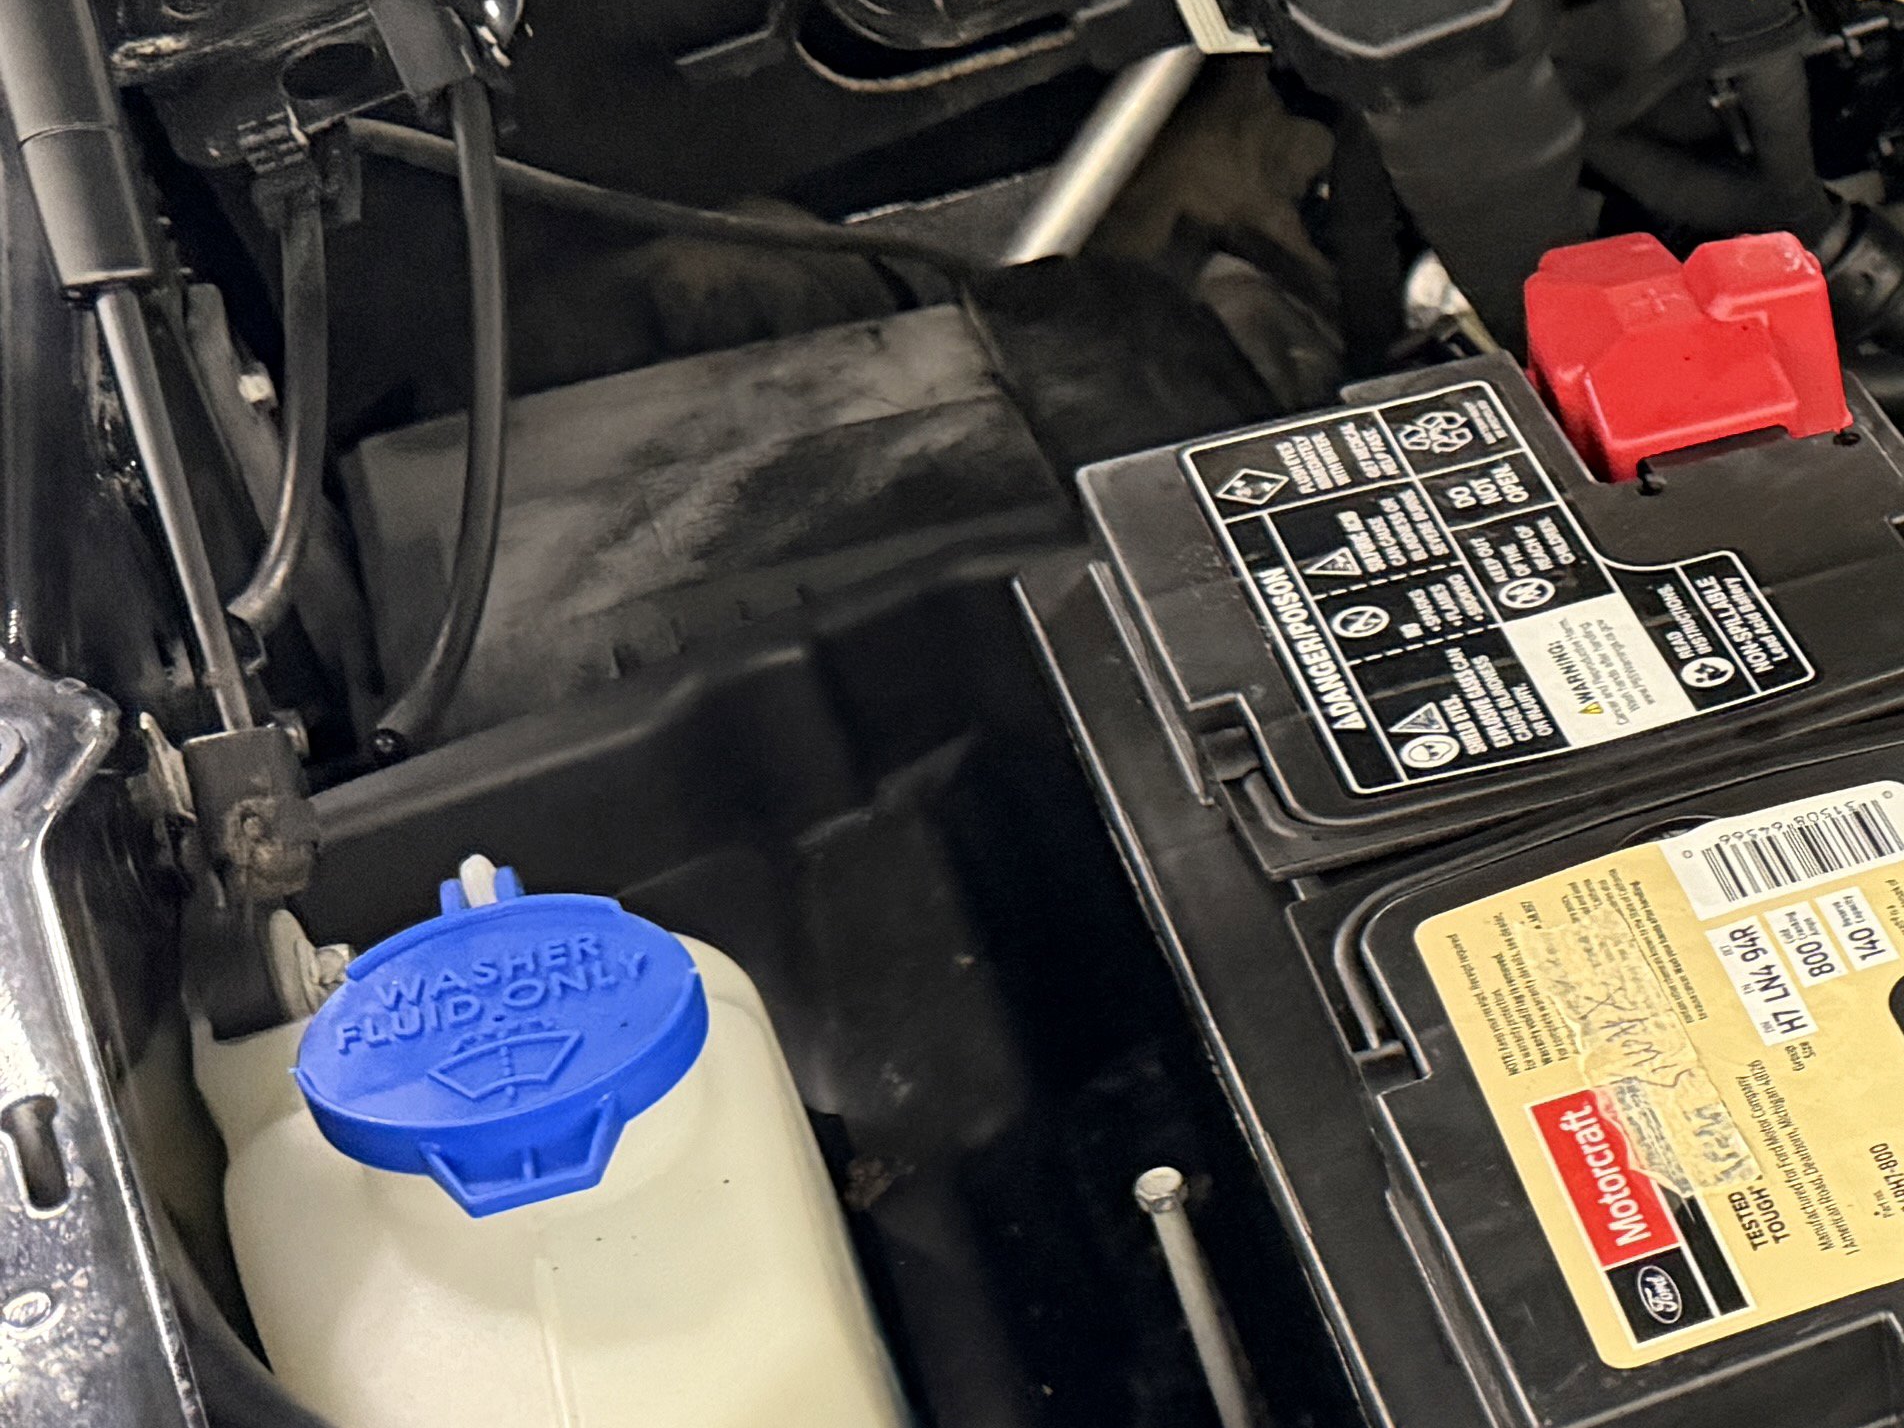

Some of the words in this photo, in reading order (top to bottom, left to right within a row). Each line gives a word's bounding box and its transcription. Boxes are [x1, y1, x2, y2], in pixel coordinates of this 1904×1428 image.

[1448, 486, 1476, 508] DO
[1469, 477, 1502, 504] NOT
[1491, 463, 1528, 502] OPEN.
[1482, 557, 1508, 582] KEEP
[1500, 543, 1523, 564] THE
[1510, 563, 1531, 576] OF
[1723, 577, 1755, 613] Battery
[1696, 576, 1772, 672] NON-SPILLABLE
[1743, 611, 1772, 634] Acid
[1259, 568, 1355, 715] DANGER/POISON
[1445, 647, 1469, 670] CAN
[1666, 631, 1694, 659] READ
[1759, 634, 1788, 661] Lead
[1454, 669, 1485, 698] GASES
[1472, 655, 1513, 708] BLINDNESS
[1548, 640, 1594, 704] WARNING:
[1454, 720, 1487, 754] SHIELD
[1470, 697, 1512, 747] EXPLOSIVE
[1502, 707, 1532, 741] CAUSE
[1531, 719, 1553, 736] OR
[1717, 821, 1784, 847] 64566
[1728, 924, 1767, 962] 94R
[1795, 940, 1835, 977] 800
[1847, 927, 1885, 960] 140
[376, 931, 602, 1012] WASHER
[1749, 964, 1790, 1002] LN4
[336, 994, 483, 1055] FLUID
[502, 950, 648, 1010] ONLY
[1771, 1009, 1807, 1034] H7
[1747, 1059, 1771, 1086] 48126
[1735, 1075, 1765, 1118] Company
[1763, 1086, 1793, 1129] Michigan
[1757, 1118, 1779, 1146] Motor
[1768, 1144, 1793, 1169] Ford
[1786, 1127, 1818, 1176] Dearborn,
[1560, 1106, 1649, 1245] Motorcraft
[1782, 1167, 1800, 1183] for
[1808, 1174, 1833, 1204] Road,
[1727, 1191, 1768, 1250] TESTED
[1789, 1182, 1833, 1251] Manufactured
[1824, 1202, 1857, 1248] American
[1876, 1200, 1894, 1218] Part
[1643, 1274, 1679, 1314] Ford
